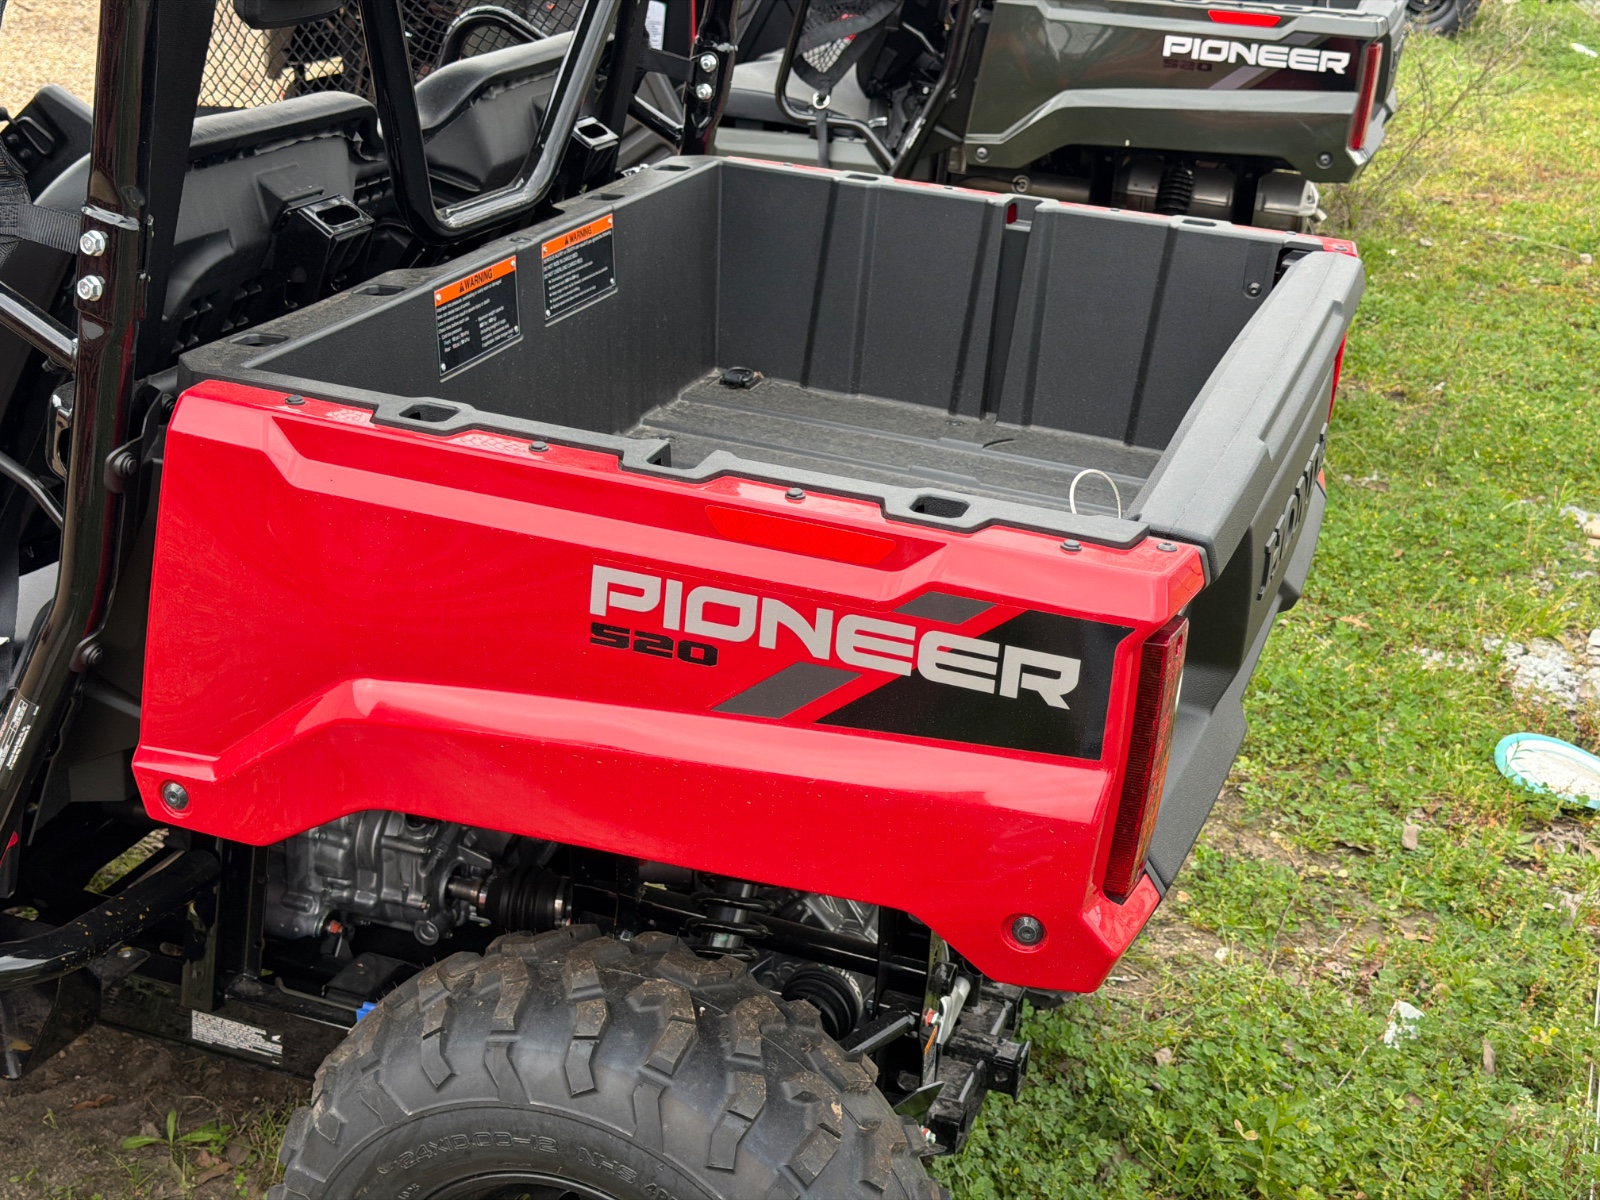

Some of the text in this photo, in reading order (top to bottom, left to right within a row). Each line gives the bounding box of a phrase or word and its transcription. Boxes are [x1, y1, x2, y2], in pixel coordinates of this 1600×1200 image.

[1162, 34, 1351, 75] PIONEER
[570, 226, 592, 244] WARNING
[464, 268, 493, 289] WARNING
[589, 564, 1081, 710] PIONEER
[577, 1146, 638, 1184] NHS
